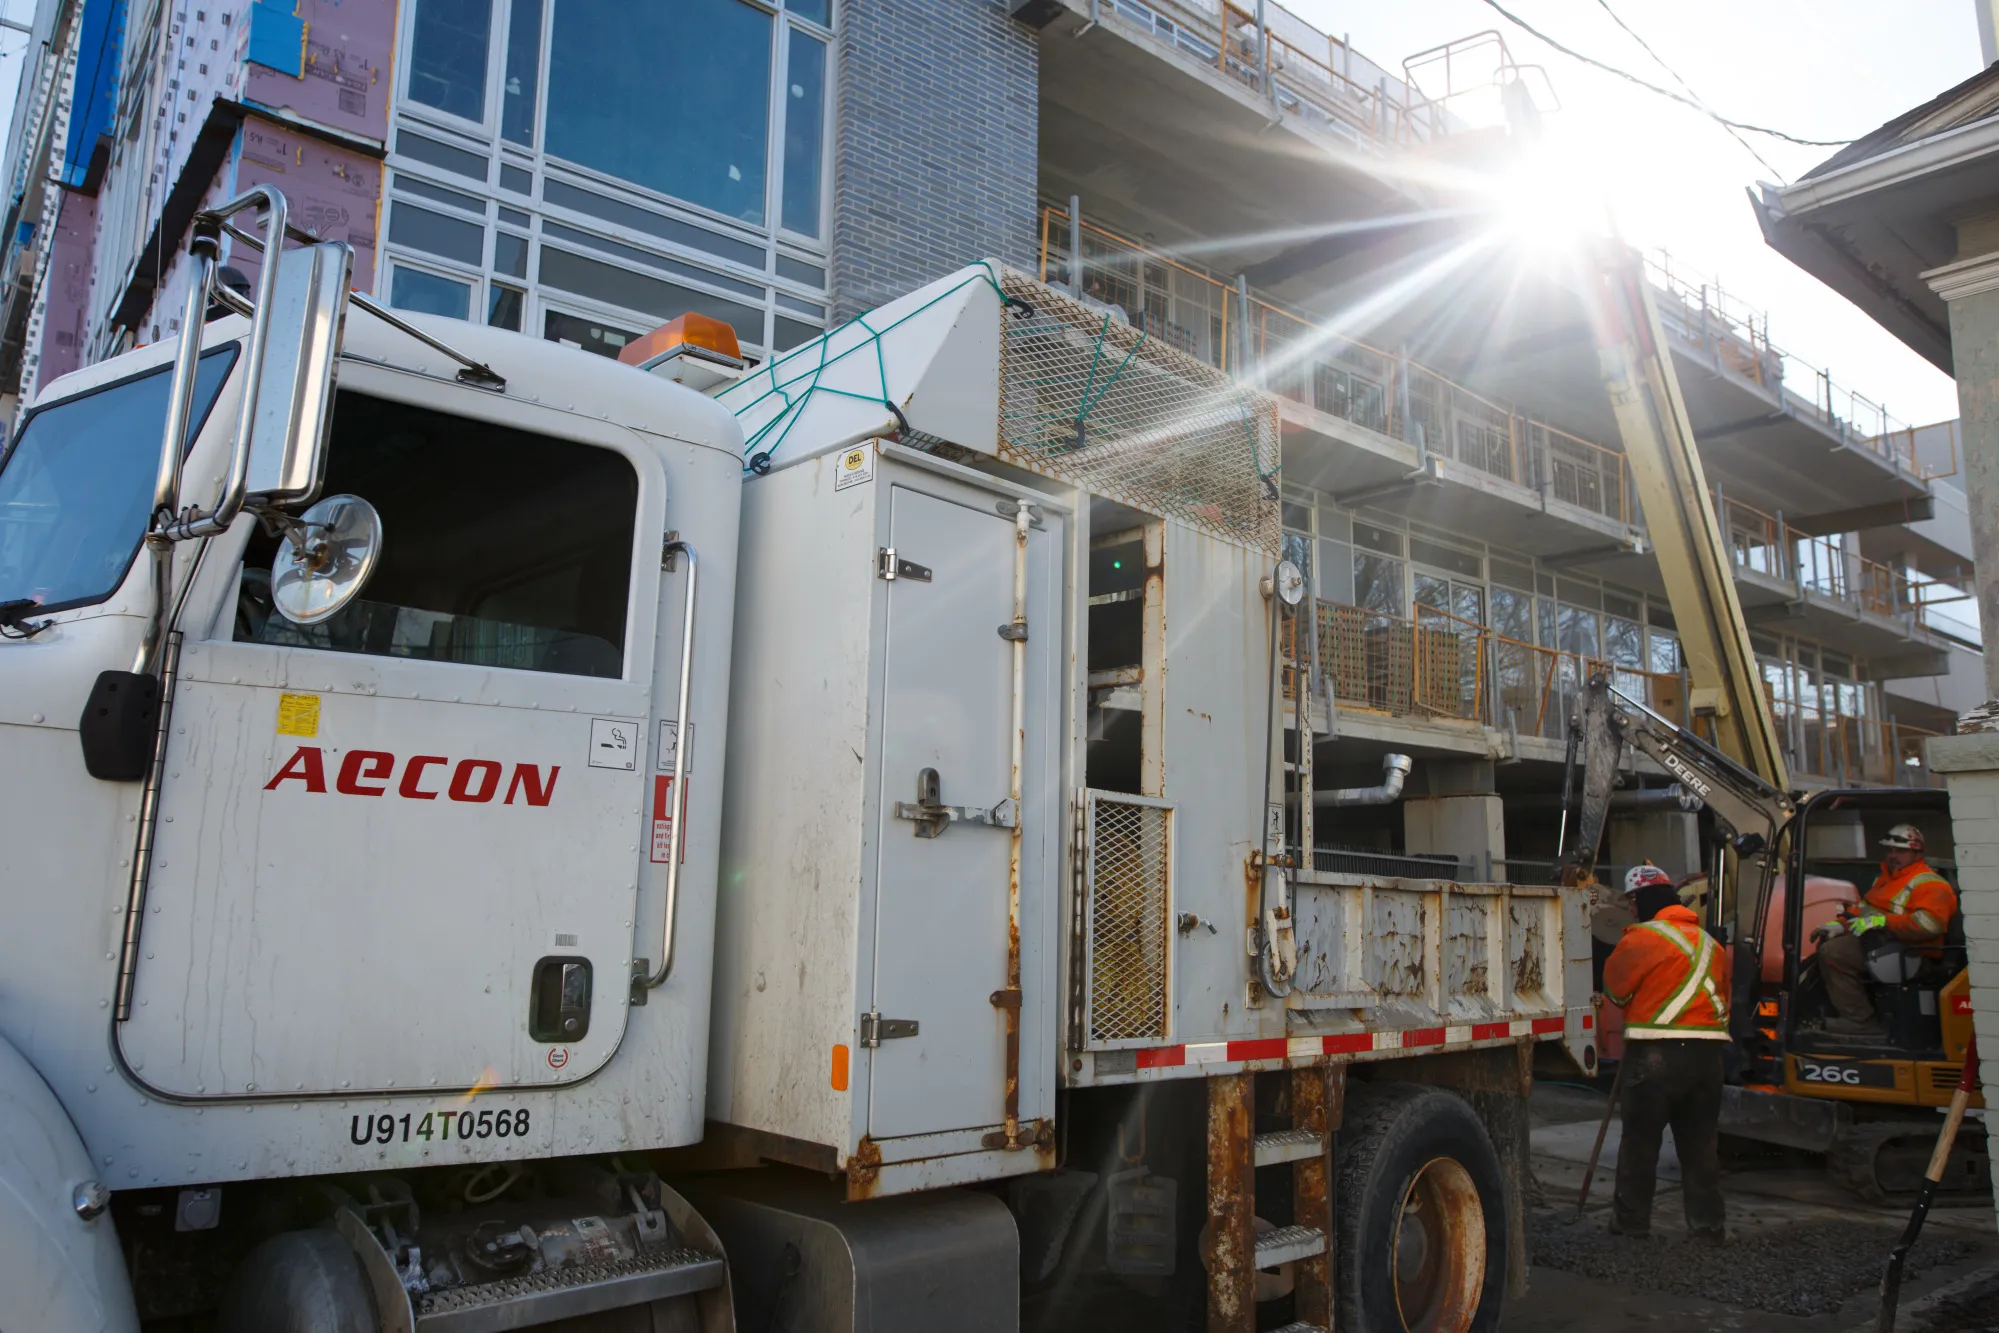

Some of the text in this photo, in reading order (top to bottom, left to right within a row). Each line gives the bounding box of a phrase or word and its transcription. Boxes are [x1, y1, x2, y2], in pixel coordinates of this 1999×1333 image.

[848, 453, 861, 465] DEL
[1664, 754, 1711, 796] DEERE
[1804, 1064, 1860, 1084] 26G
[351, 1109, 530, 1146] U914T0568
